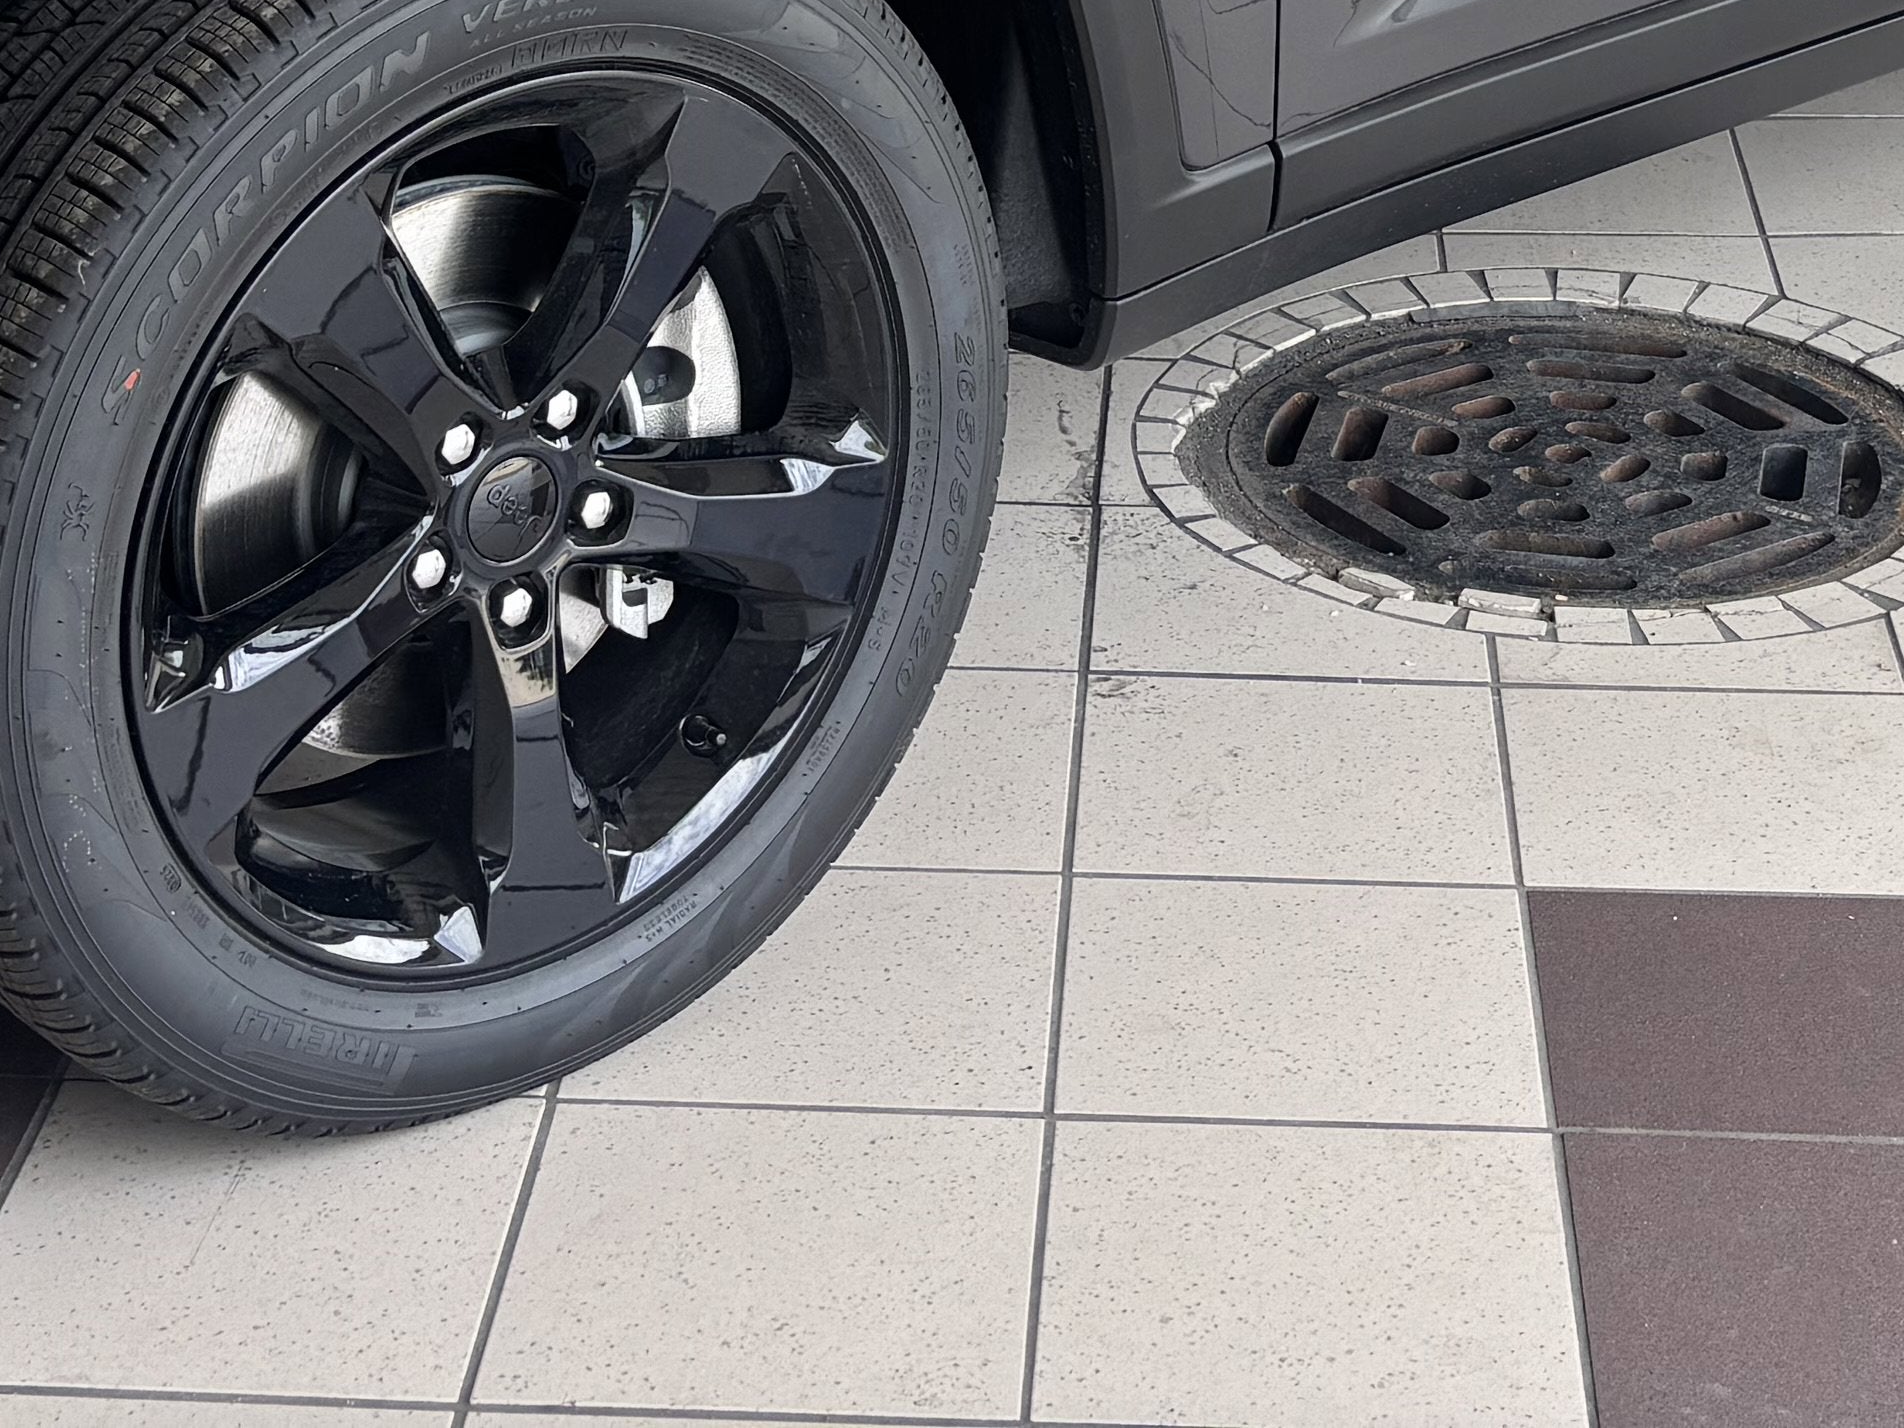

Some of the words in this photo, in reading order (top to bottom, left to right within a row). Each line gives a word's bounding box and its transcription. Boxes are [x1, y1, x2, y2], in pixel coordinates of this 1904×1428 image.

[468, 30, 506, 50] ALL
[511, 6, 598, 34] SEASON
[100, 30, 431, 427] SCORPION
[939, 331, 978, 556] 265/50
[895, 569, 947, 698] R20
[218, 1002, 418, 1097] PIRELLI
